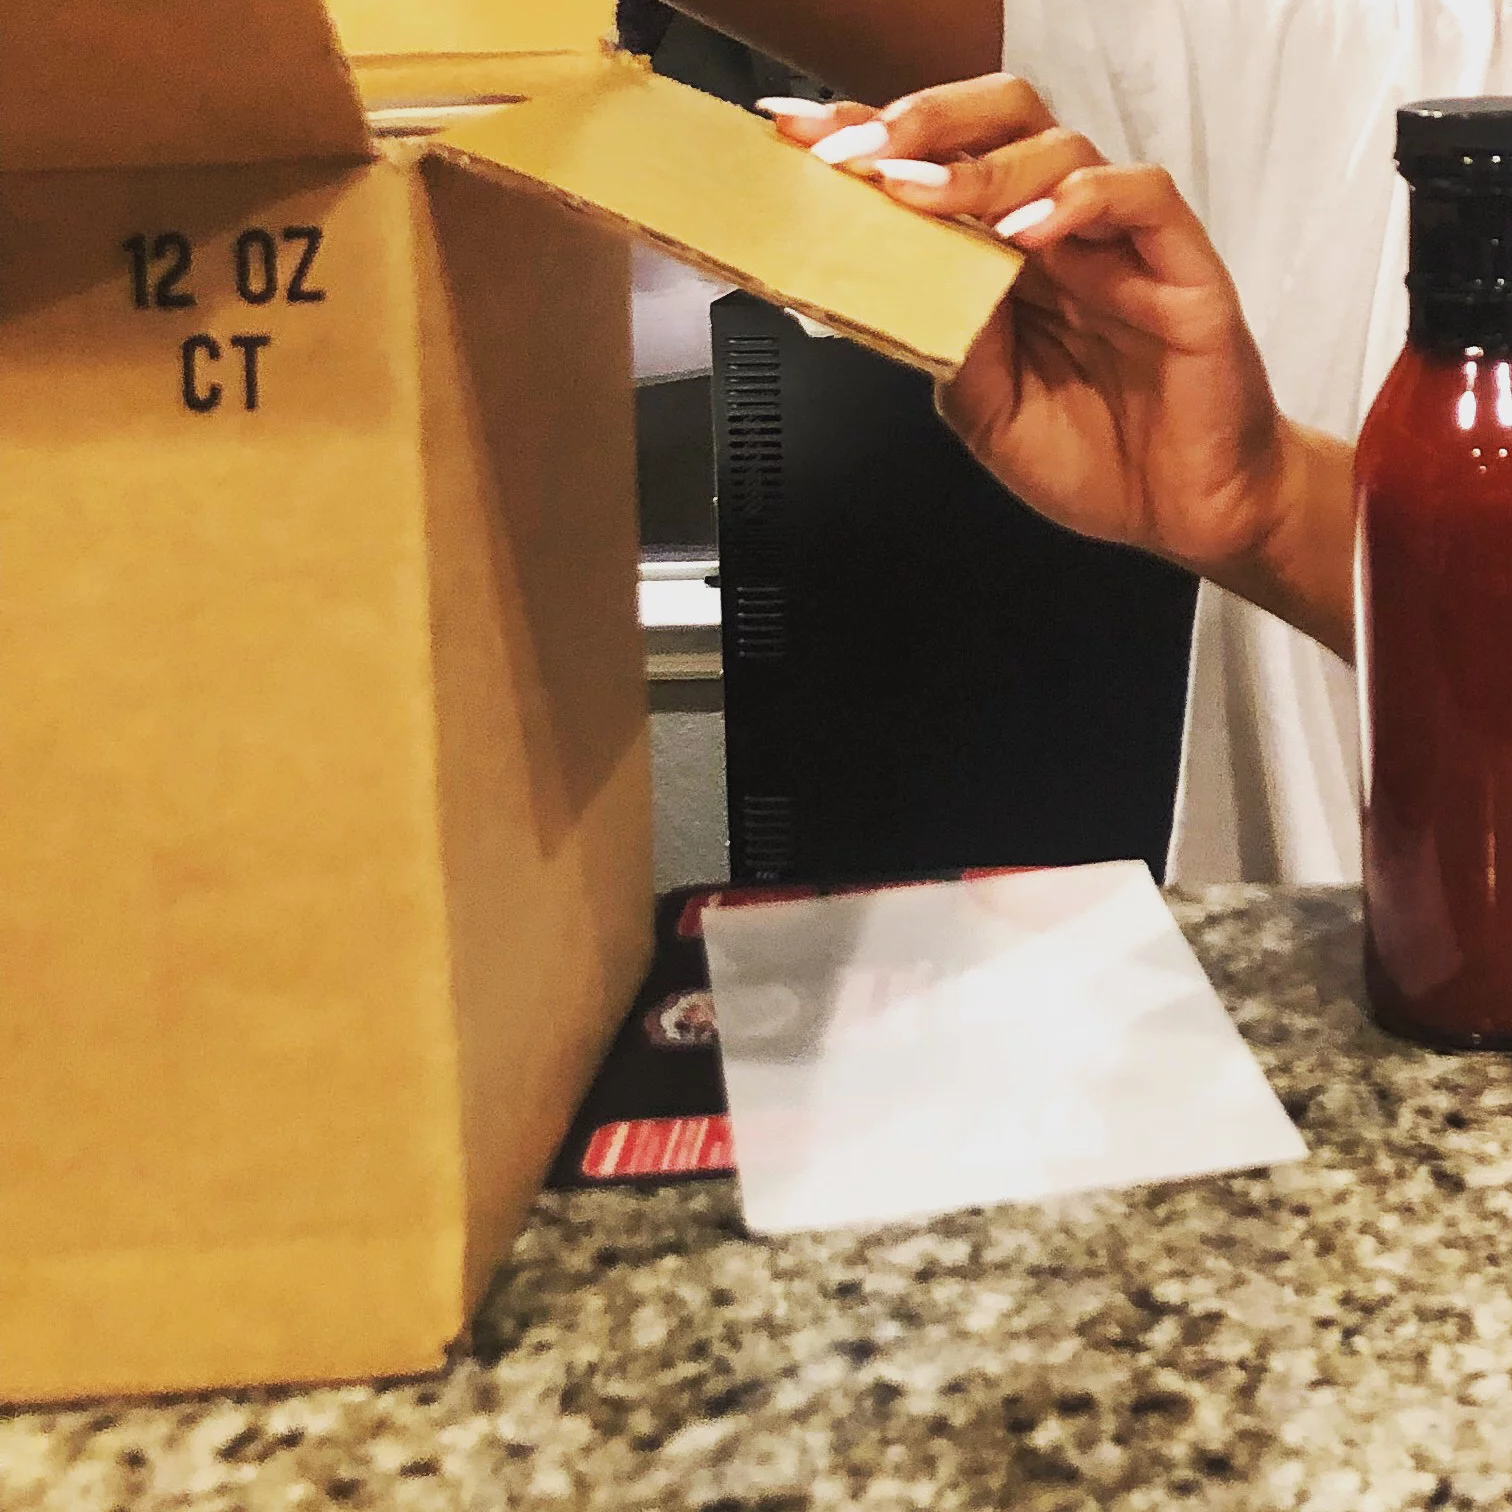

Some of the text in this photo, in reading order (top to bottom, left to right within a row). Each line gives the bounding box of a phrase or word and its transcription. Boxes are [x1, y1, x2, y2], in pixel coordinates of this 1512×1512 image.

[121, 225, 326, 312] 12 OZ
[181, 333, 272, 413] CT
